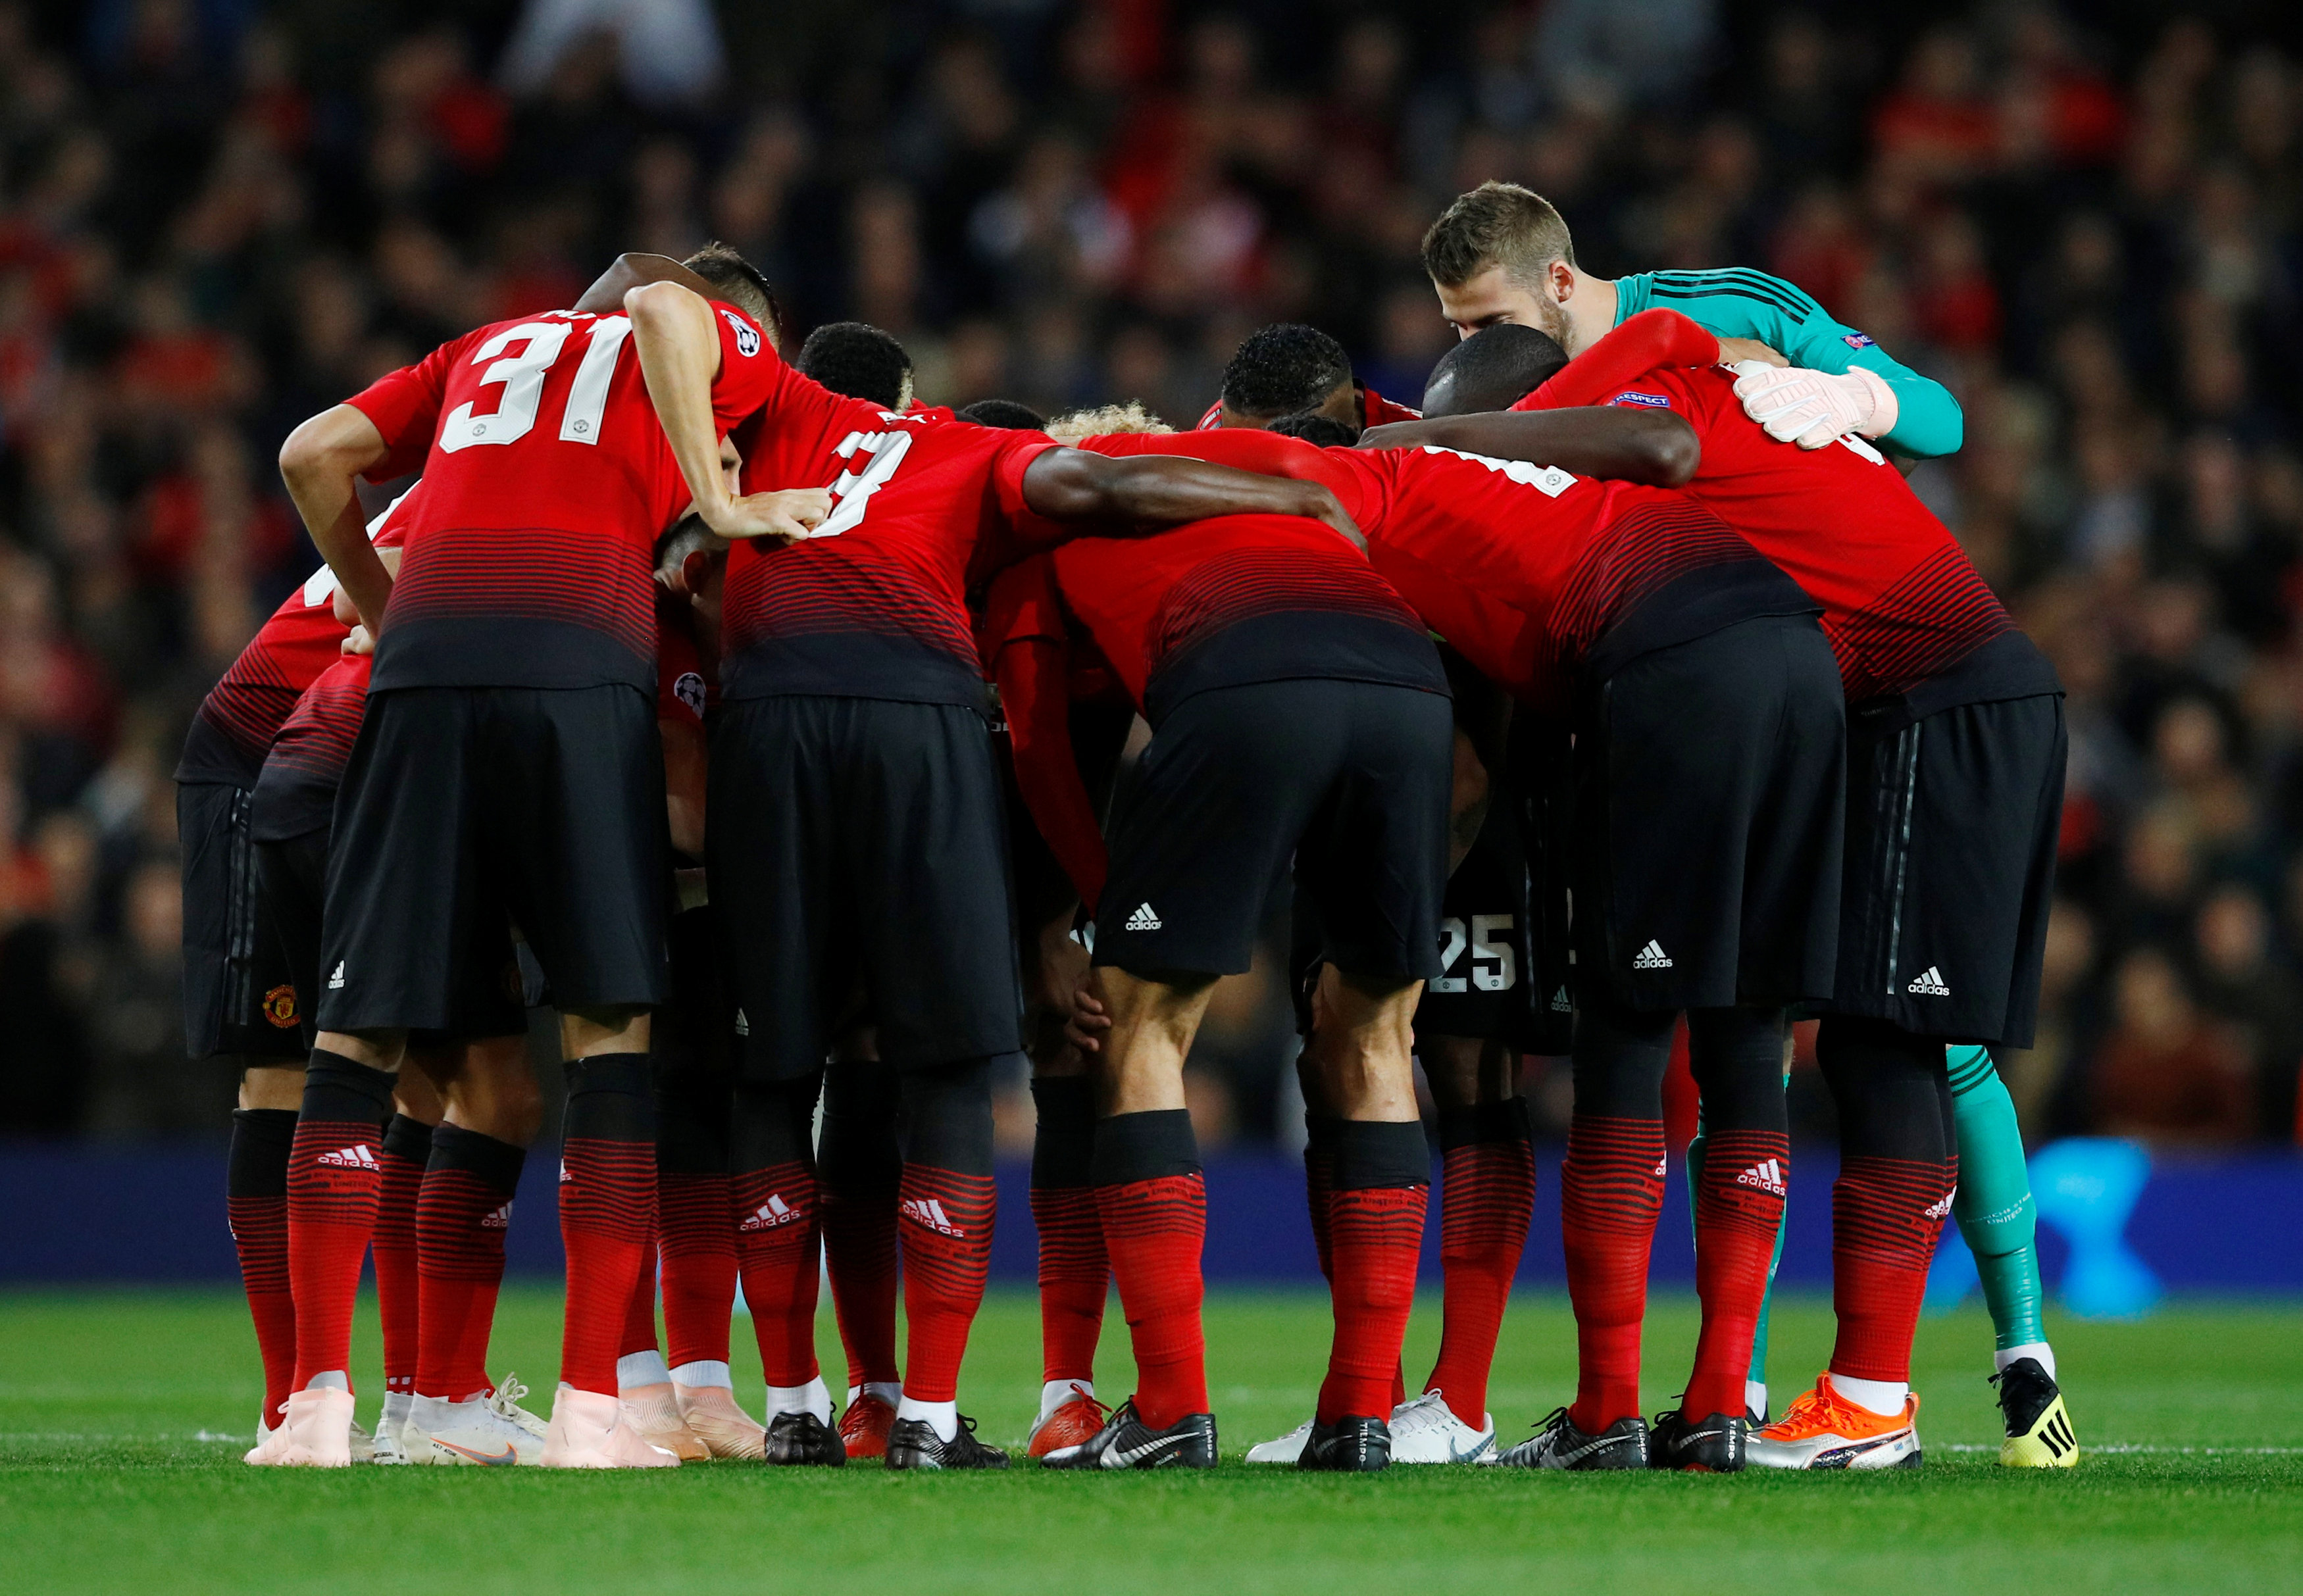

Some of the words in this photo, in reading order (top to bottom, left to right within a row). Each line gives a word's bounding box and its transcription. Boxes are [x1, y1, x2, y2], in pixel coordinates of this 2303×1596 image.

[439, 315, 632, 453] 31
[1126, 920, 1162, 931] adidas
[1429, 914, 1516, 993] 25
[1633, 957, 1673, 969] adidas
[1908, 983, 1950, 997] adidas
[318, 1156, 380, 1171] adidas
[1736, 1174, 1786, 1196] adidas
[481, 1218, 509, 1228] adid
[740, 1209, 801, 1231] adidas
[903, 1205, 964, 1237] adidas
[1987, 1207, 2023, 1224] UNITED
[1205, 1419, 1213, 1460] TIEMPO
[1358, 1422, 1369, 1462] TIEMPO
[1638, 1423, 1647, 1462] TIEMPO
[1728, 1419, 1737, 1460] TIEMPO
